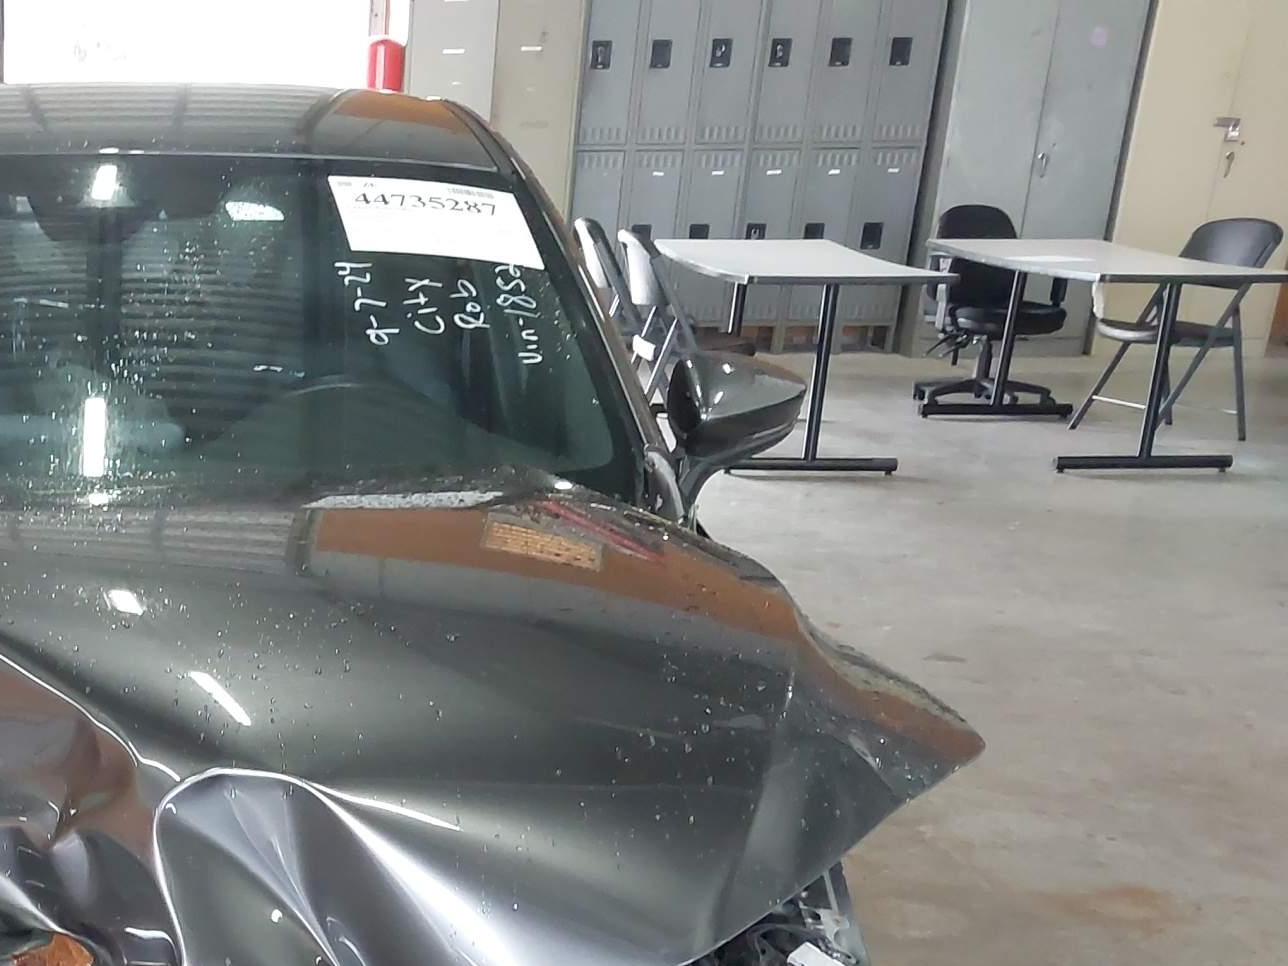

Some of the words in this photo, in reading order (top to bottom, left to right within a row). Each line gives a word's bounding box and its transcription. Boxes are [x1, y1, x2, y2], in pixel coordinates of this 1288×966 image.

[355, 193, 496, 216] 44735287
[334, 262, 400, 345] 9-7-24
[449, 279, 491, 329] Rob
